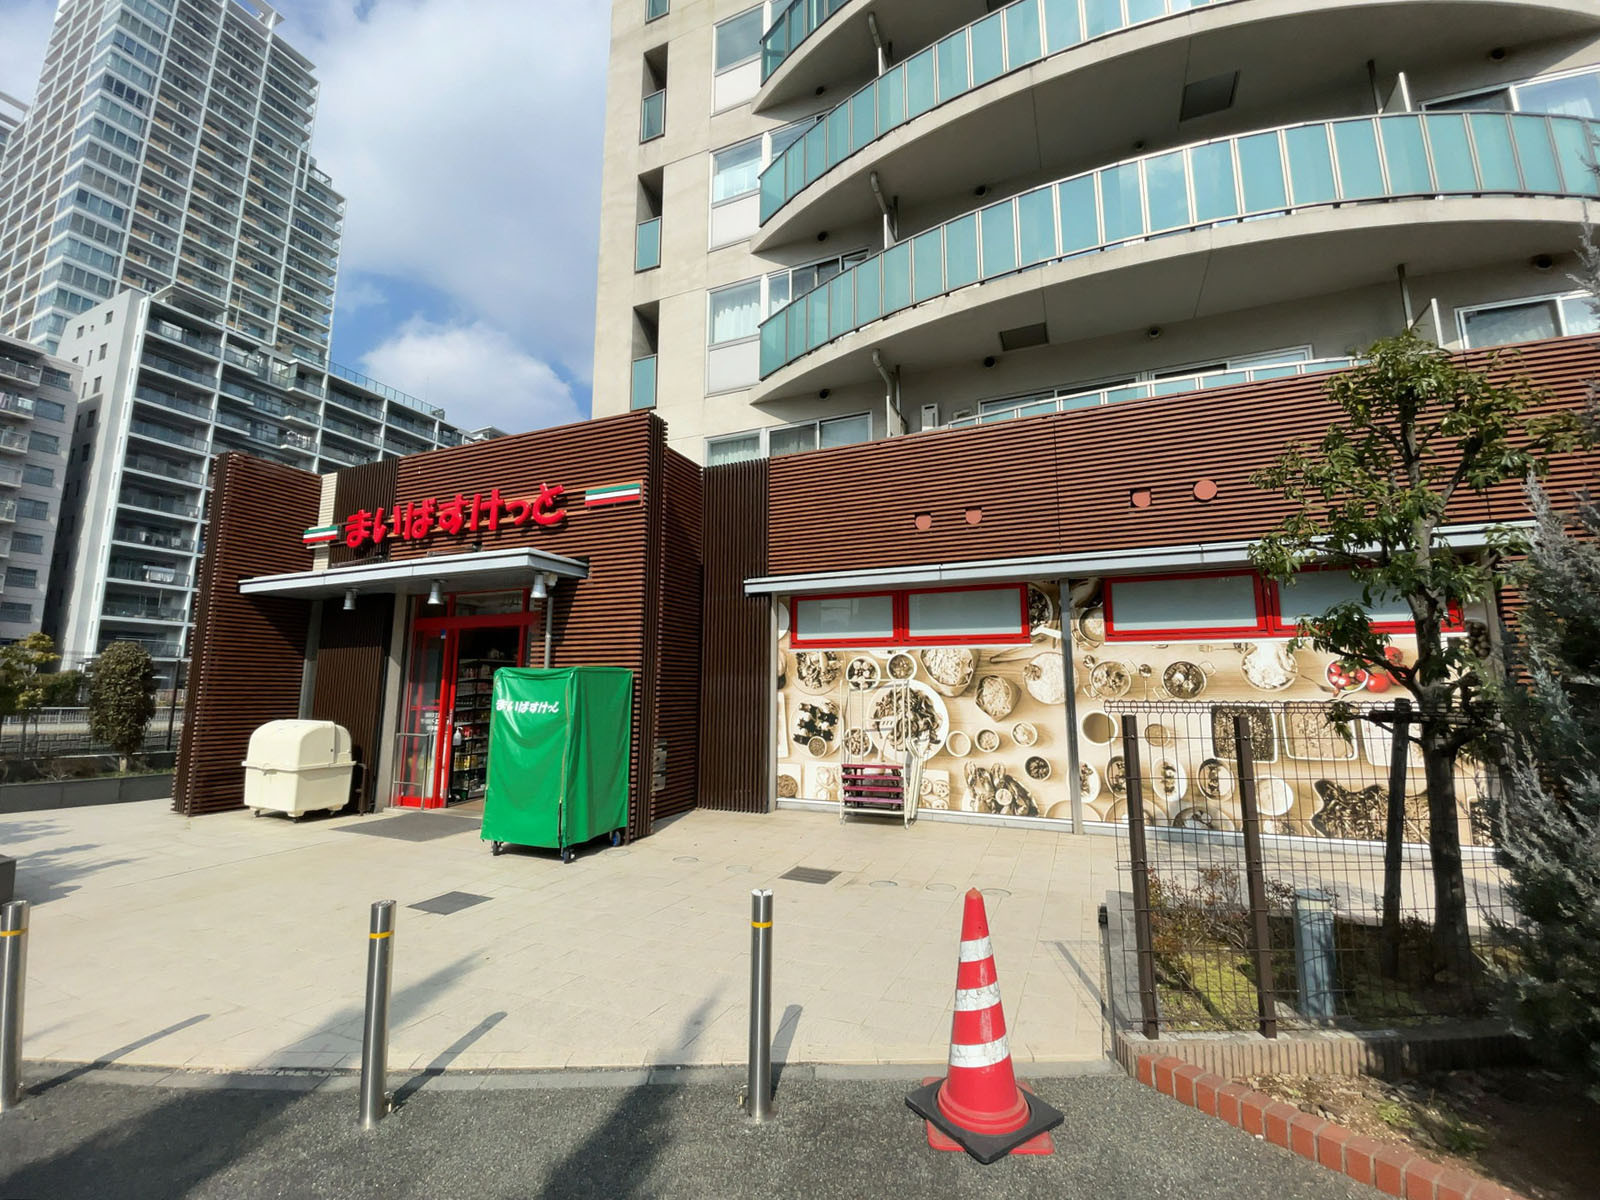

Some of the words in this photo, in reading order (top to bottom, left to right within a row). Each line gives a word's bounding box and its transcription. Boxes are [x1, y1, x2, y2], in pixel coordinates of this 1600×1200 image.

[345, 483, 566, 547] まいばすけっと
[496, 699, 559, 713] まいばすけっと
